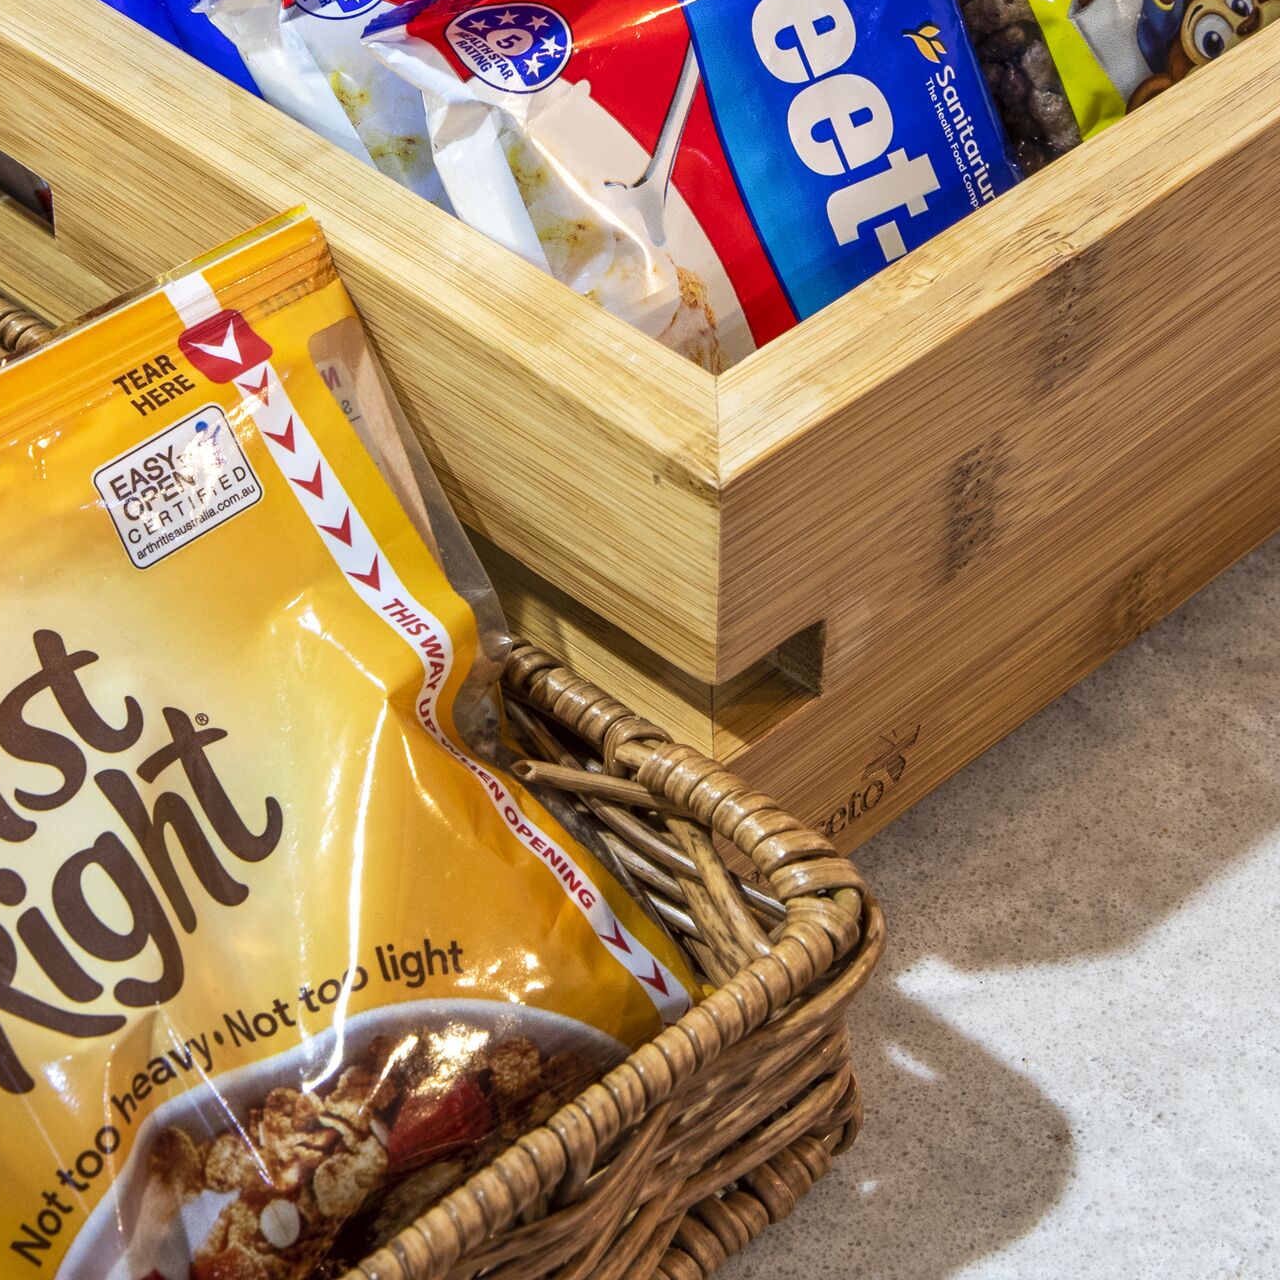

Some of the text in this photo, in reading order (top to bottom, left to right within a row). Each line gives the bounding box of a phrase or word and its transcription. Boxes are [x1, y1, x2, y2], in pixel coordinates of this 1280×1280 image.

[454, 31, 516, 82] HEALTH STAR
[456, 40, 489, 73] RATING
[495, 33, 515, 51] 5
[925, 77, 980, 211] The Health Food Comp
[113, 354, 177, 396] TEAR
[130, 374, 196, 416] HERE
[110, 445, 175, 500] EASY
[123, 470, 196, 521] OPEN
[128, 466, 247, 544] CERTIFIED
[137, 484, 255, 560] arthritisaustralia.com.au
[382, 597, 597, 911] THIS WAY UP WHEN OPENING
[10, 939, 465, 1268] Not too heavy Not too light
